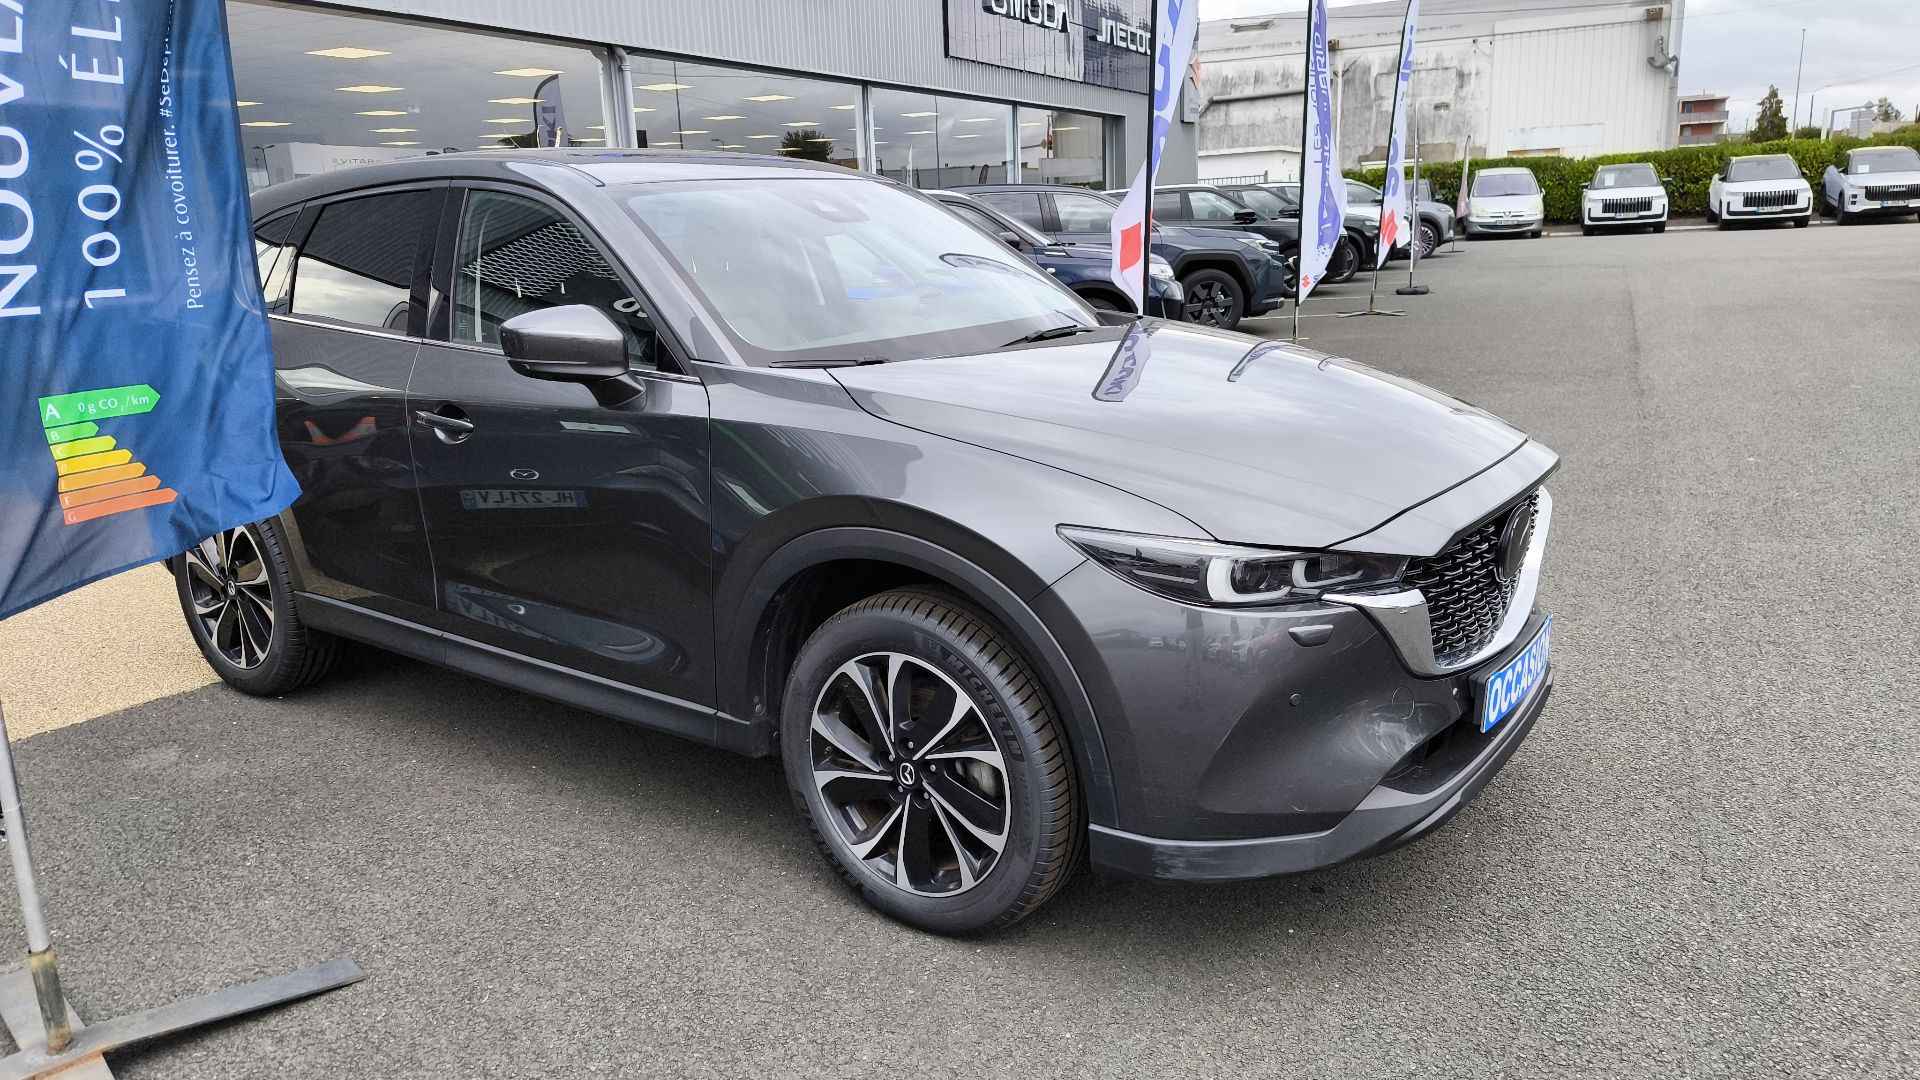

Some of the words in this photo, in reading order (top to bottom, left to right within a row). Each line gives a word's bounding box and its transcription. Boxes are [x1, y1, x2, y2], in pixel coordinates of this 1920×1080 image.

[165, 124, 189, 225] covoiturer.
[174, 230, 193, 242] à
[182, 246, 204, 310] Pensez
[45, 403, 61, 421] A
[50, 430, 60, 441] B
[946, 653, 1022, 757] MICHELIN
